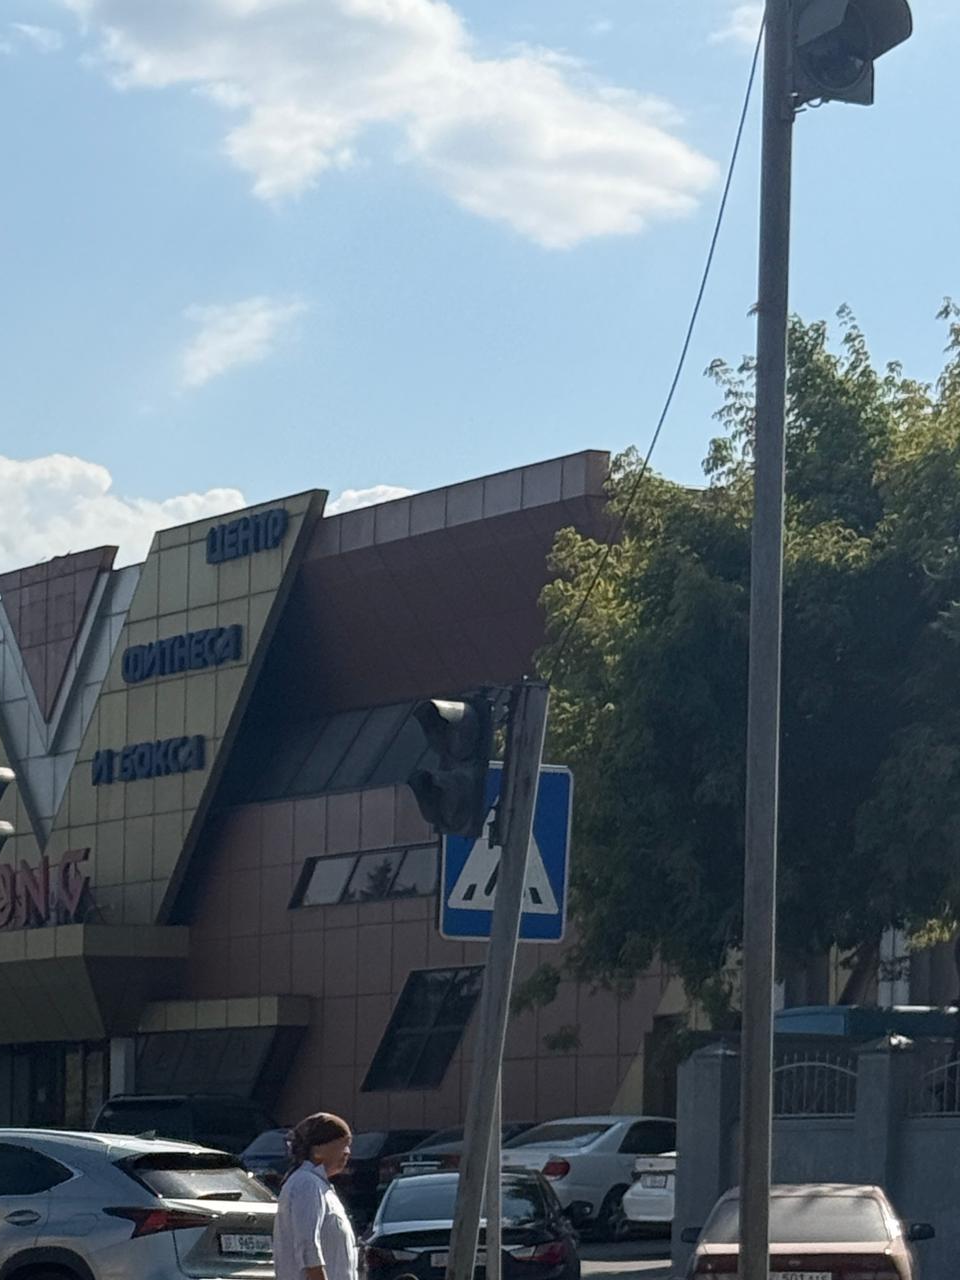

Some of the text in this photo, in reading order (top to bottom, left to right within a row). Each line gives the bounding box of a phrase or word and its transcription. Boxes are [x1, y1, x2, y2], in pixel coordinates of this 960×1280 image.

[207, 508, 289, 564] ЦЕНТР
[123, 624, 243, 684] ФИТНЕСА
[91, 734, 207, 786] И БОКСА
